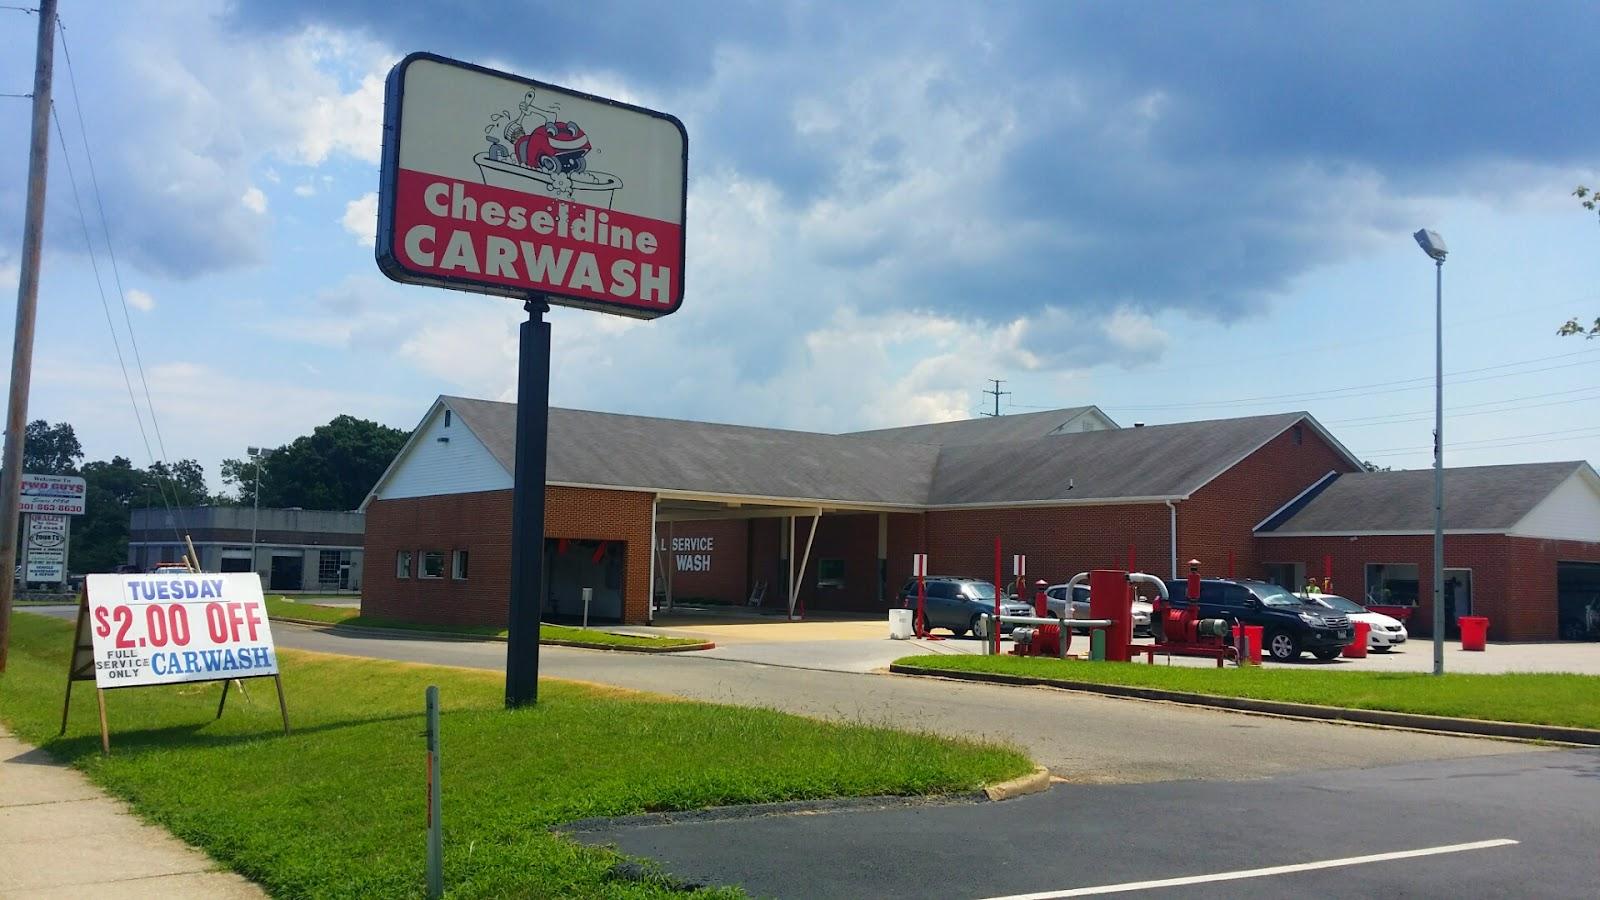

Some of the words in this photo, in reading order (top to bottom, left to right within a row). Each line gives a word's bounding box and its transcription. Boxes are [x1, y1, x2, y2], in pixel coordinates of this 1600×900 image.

[423, 182, 659, 255] Cheseldine
[404, 224, 671, 305] CARWASH
[20, 480, 48, 490] TWO
[51, 483, 84, 493] GUYS
[672, 537, 714, 551] SERVICE
[676, 554, 711, 572] WASH
[127, 579, 224, 601] TUESDAY
[94, 603, 191, 649] $2.00
[205, 602, 262, 644] OFF
[96, 658, 150, 670] SERVICE
[106, 650, 138, 660] FULL
[151, 647, 272, 676] CARWASH
[108, 669, 139, 679] ONLY
